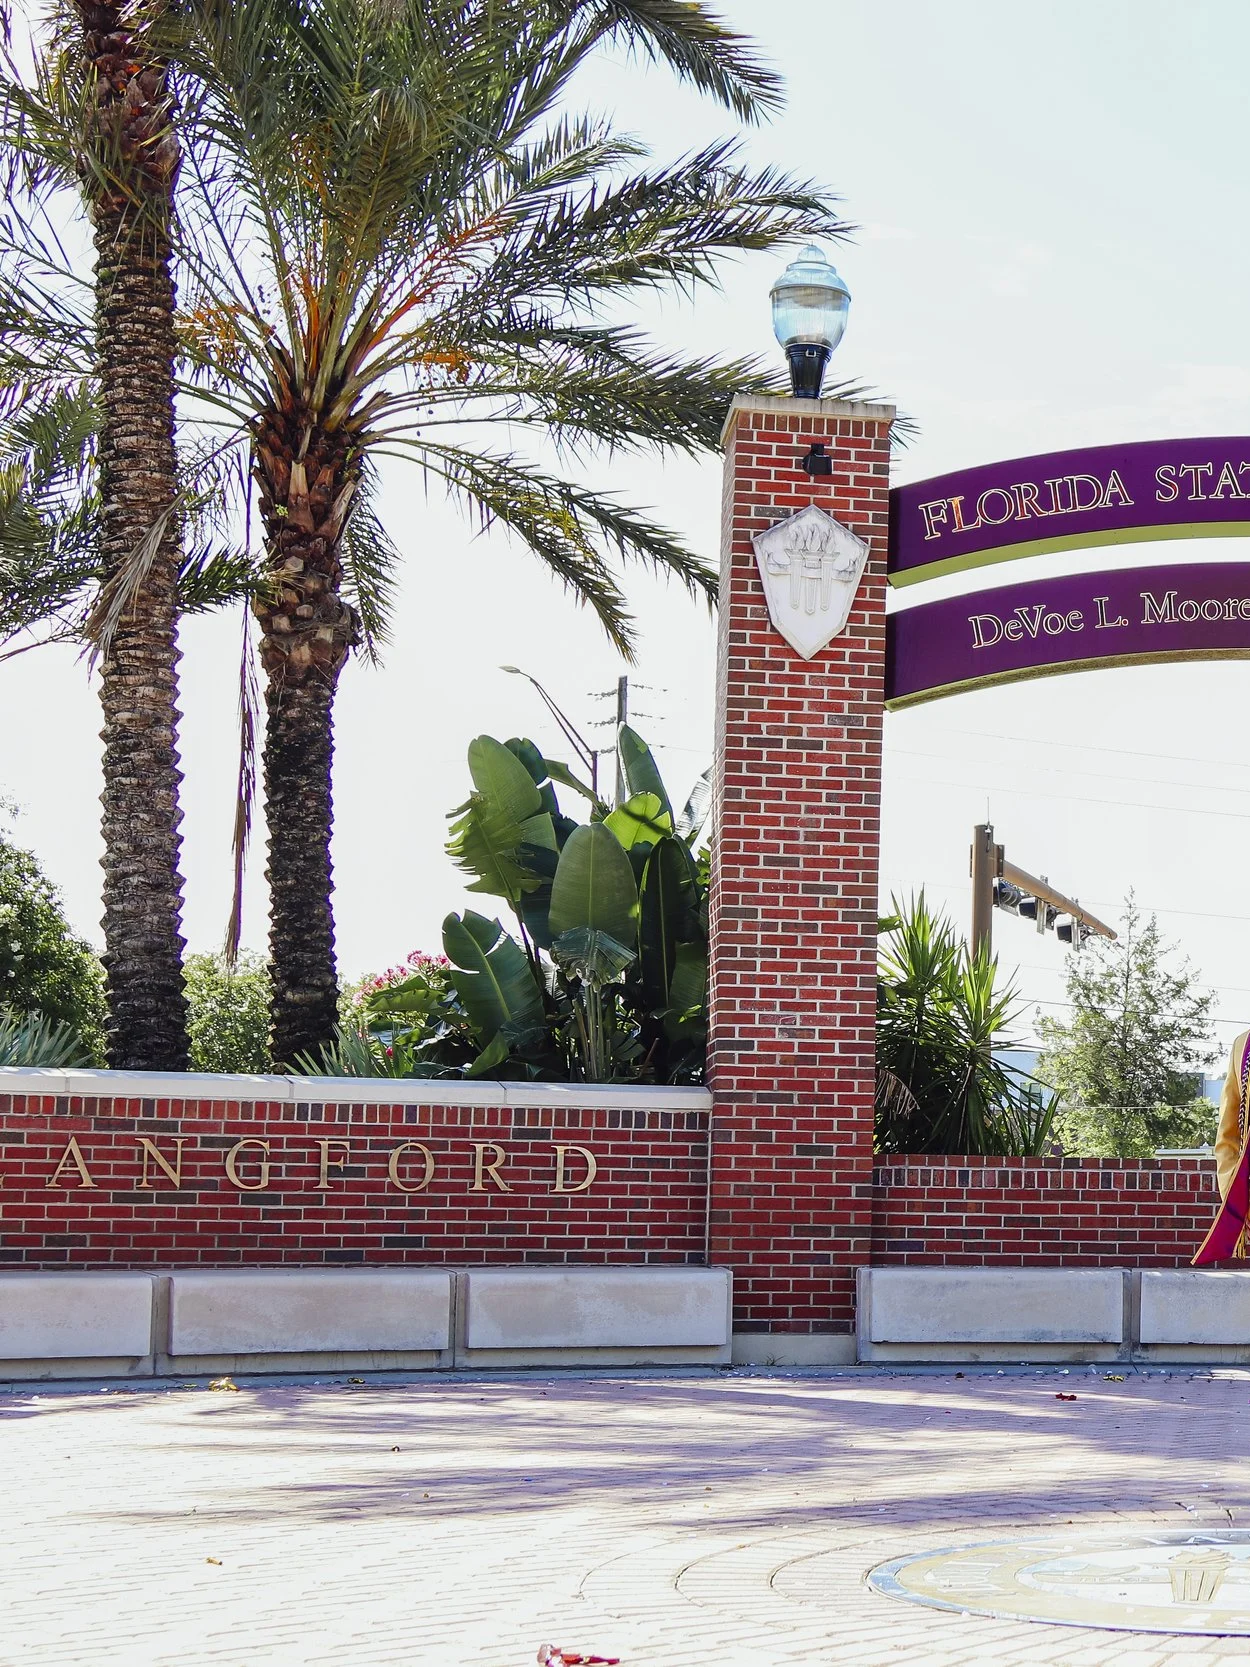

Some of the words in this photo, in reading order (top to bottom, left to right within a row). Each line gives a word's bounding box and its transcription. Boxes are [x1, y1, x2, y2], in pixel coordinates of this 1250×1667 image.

[918, 470, 1134, 540] FLORIDA
[968, 604, 1085, 648] DeVoe
[1093, 597, 1129, 628] L.
[0, 1135, 598, 1193] ANGFORD
